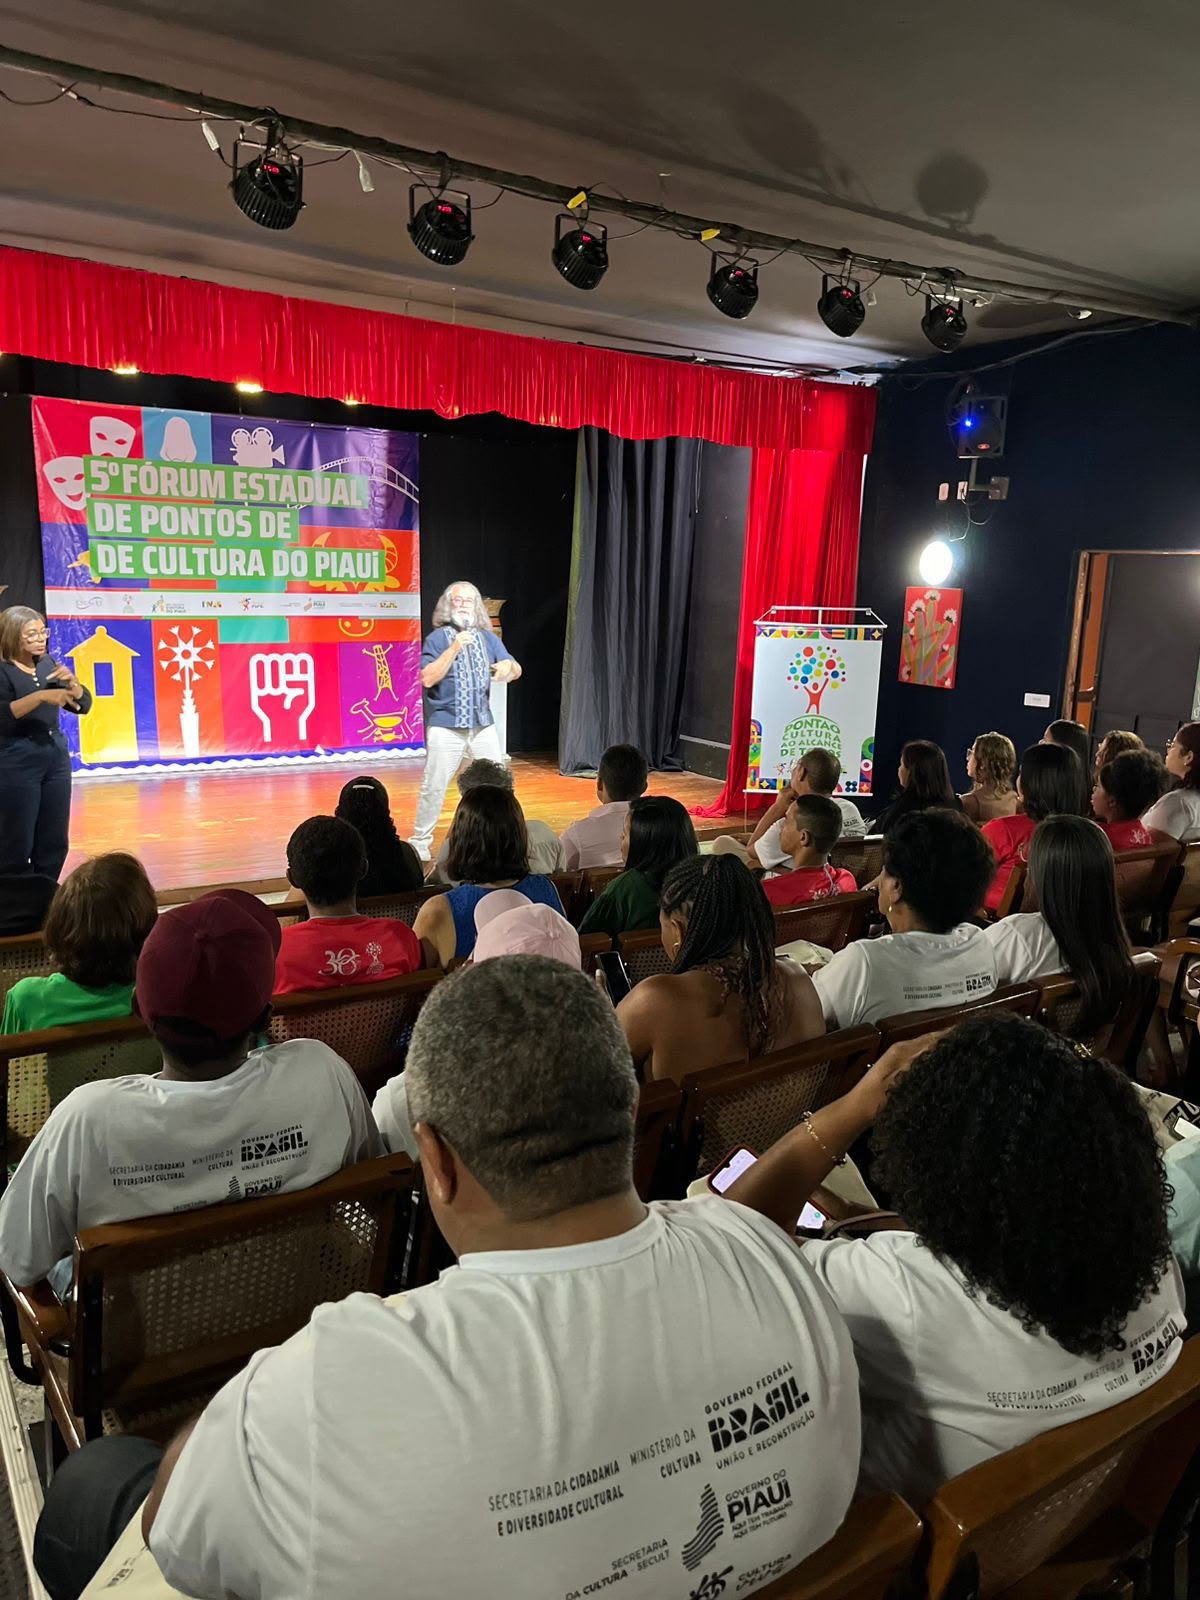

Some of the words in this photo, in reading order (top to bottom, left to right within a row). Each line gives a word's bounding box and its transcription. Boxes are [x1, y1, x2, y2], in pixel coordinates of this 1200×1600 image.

[90, 459, 120, 492] 5º
[122, 461, 226, 499] FÓRUM
[233, 471, 362, 506] ESTADUAL
[94, 502, 133, 533] DE
[140, 504, 252, 538] PONTOS
[259, 510, 291, 539] DE
[97, 543, 134, 574] DE
[142, 545, 266, 577] CULTURA
[272, 549, 308, 577] DO
[780, 740, 796, 749] AO
[798, 739, 841, 750] ALCANCE
[782, 729, 841, 742] CULTURA
[780, 748, 796, 757] DE
[241, 1131, 309, 1162] BRASIL
[153, 1162, 185, 1171] CIDADANIA
[155, 1171, 185, 1182] CULTURAL
[207, 1160, 233, 1171] CULTURA
[704, 1386, 754, 1415] GOVERNO
[756, 1361, 793, 1390] FEDERAL
[986, 1391, 1035, 1402] SECRETARIA
[1035, 1389, 1046, 1400] DA
[707, 1376, 810, 1453] BRASIL
[683, 1428, 696, 1444] DA
[716, 1450, 745, 1470] UNIÃO
[748, 1446, 754, 1456] E
[756, 1409, 815, 1452] RECONSTRUÇÃO
[660, 1450, 702, 1479] CULTURA
[488, 1484, 553, 1512] SECRETARIA
[554, 1479, 568, 1496] DA
[569, 1459, 620, 1491] CIDADANIA
[725, 1476, 771, 1502] GOVERNO
[772, 1468, 786, 1481] DO
[497, 1521, 504, 1537] E
[506, 1503, 575, 1535] DIVERSIDADE
[575, 1484, 625, 1515] CULTURAL
[611, 1538, 669, 1571] SECRETARIA
[582, 1569, 629, 1595] CULTURA
[637, 1549, 670, 1571] SECULT
